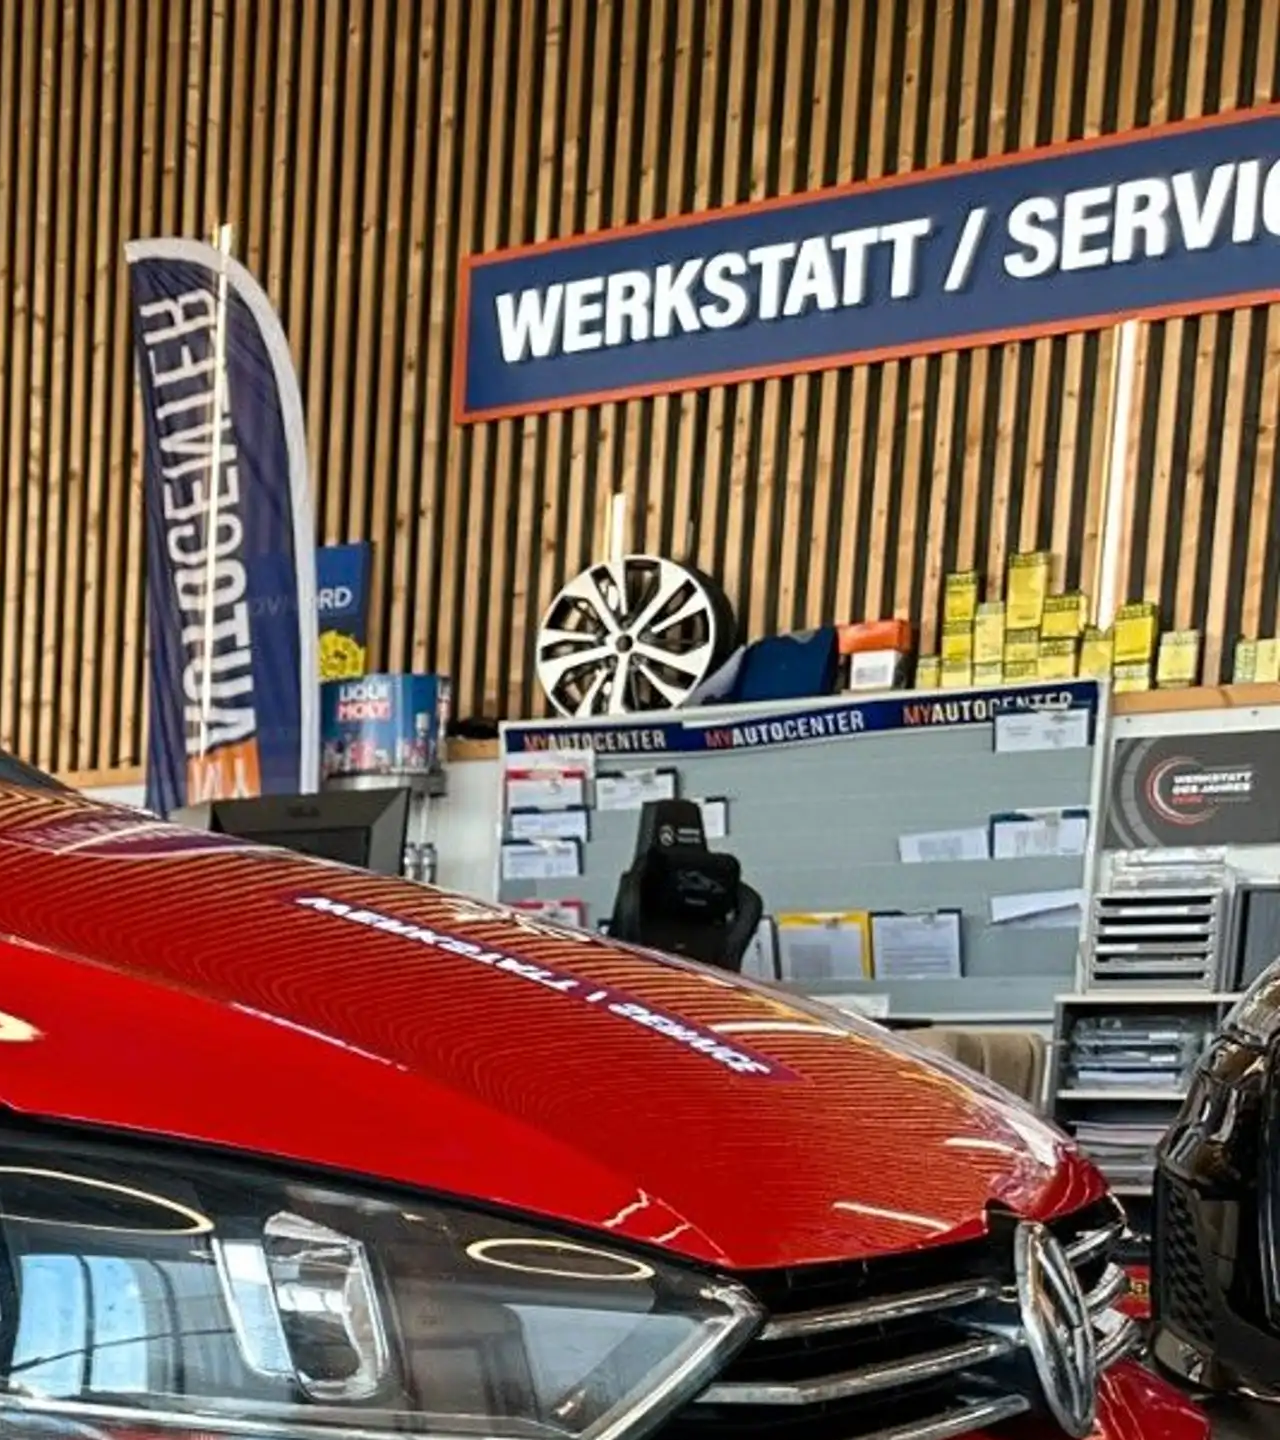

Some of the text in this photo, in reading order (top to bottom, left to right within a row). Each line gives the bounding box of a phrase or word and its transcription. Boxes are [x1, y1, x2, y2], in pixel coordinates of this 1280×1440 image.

[495, 218, 932, 364] WERKSTATT
[944, 208, 986, 291] /
[704, 710, 865, 748] MYAUTOCENTER
